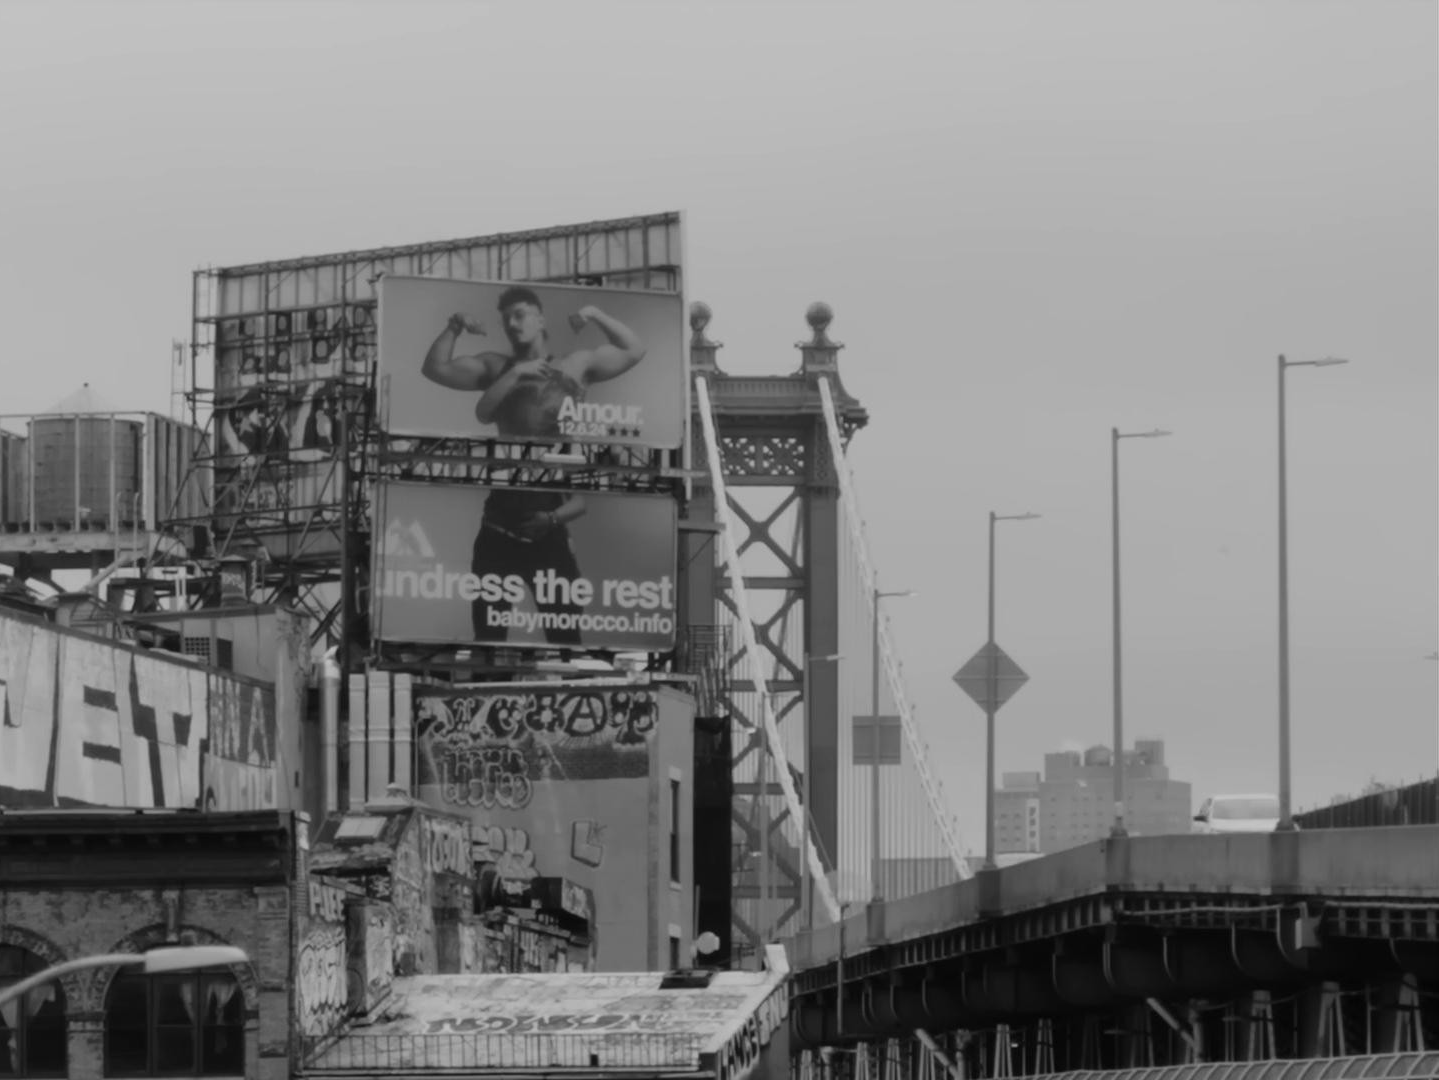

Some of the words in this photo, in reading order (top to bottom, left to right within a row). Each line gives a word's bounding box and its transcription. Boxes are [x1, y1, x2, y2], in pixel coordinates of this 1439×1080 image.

[557, 395, 644, 425] Amour.
[375, 563, 526, 603] undress
[533, 567, 593, 606] the
[602, 575, 673, 610] rest
[486, 604, 673, 635] babymorocco.info
